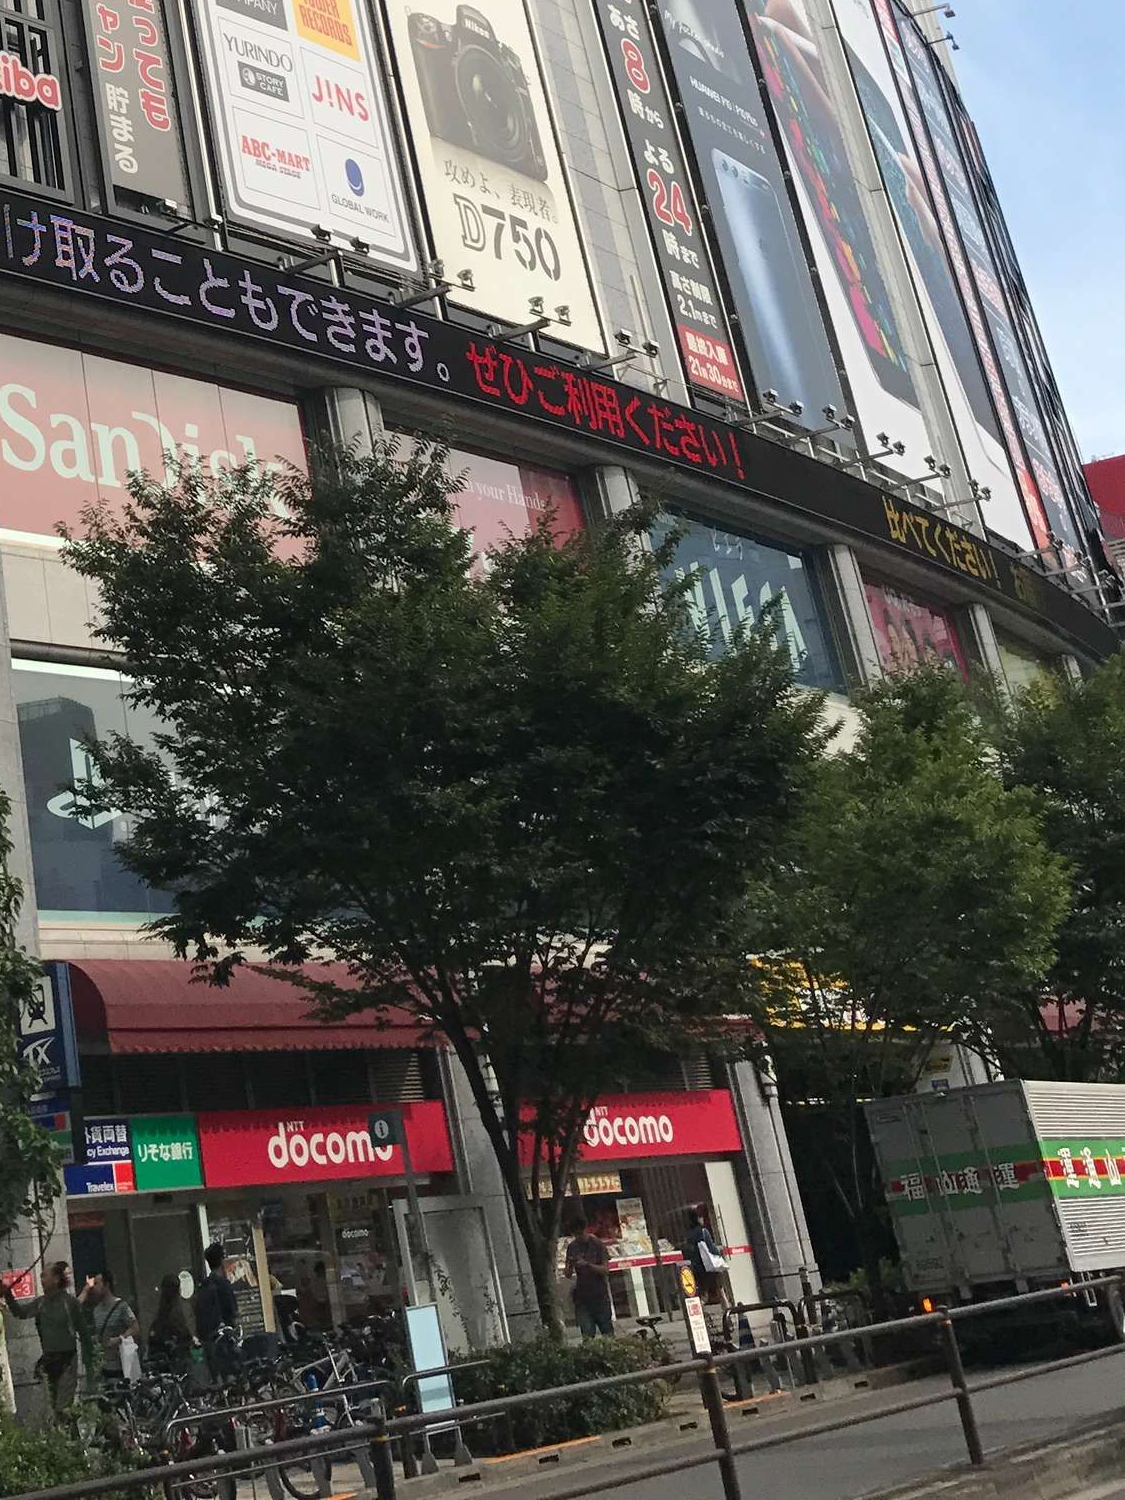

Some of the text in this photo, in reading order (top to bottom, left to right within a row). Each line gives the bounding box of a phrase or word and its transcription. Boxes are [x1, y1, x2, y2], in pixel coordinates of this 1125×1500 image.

[299, 4, 352, 46] RECORDS
[609, 4, 639, 40] あさ
[223, 32, 293, 73] YURINDO
[620, 37, 650, 94] 8
[255, 71, 285, 89] STORY
[258, 79, 284, 97] CAFE
[628, 88, 664, 130] 時から
[241, 135, 310, 172] ABC-MART
[644, 139, 673, 174] よる
[331, 193, 390, 224] GLOBAL WORK
[646, 167, 692, 237] 24
[452, 192, 562, 283] D750
[662, 229, 700, 269] 時まで
[475, 481, 505, 500] your
[286, 1120, 305, 1133] NTT
[583, 1107, 674, 1148] docomo
[595, 1106, 608, 1117] NTT
[97, 1146, 130, 1157] Exchange
[137, 1140, 193, 1164] りそな銀行
[900, 1163, 1020, 1201] 福山通運
